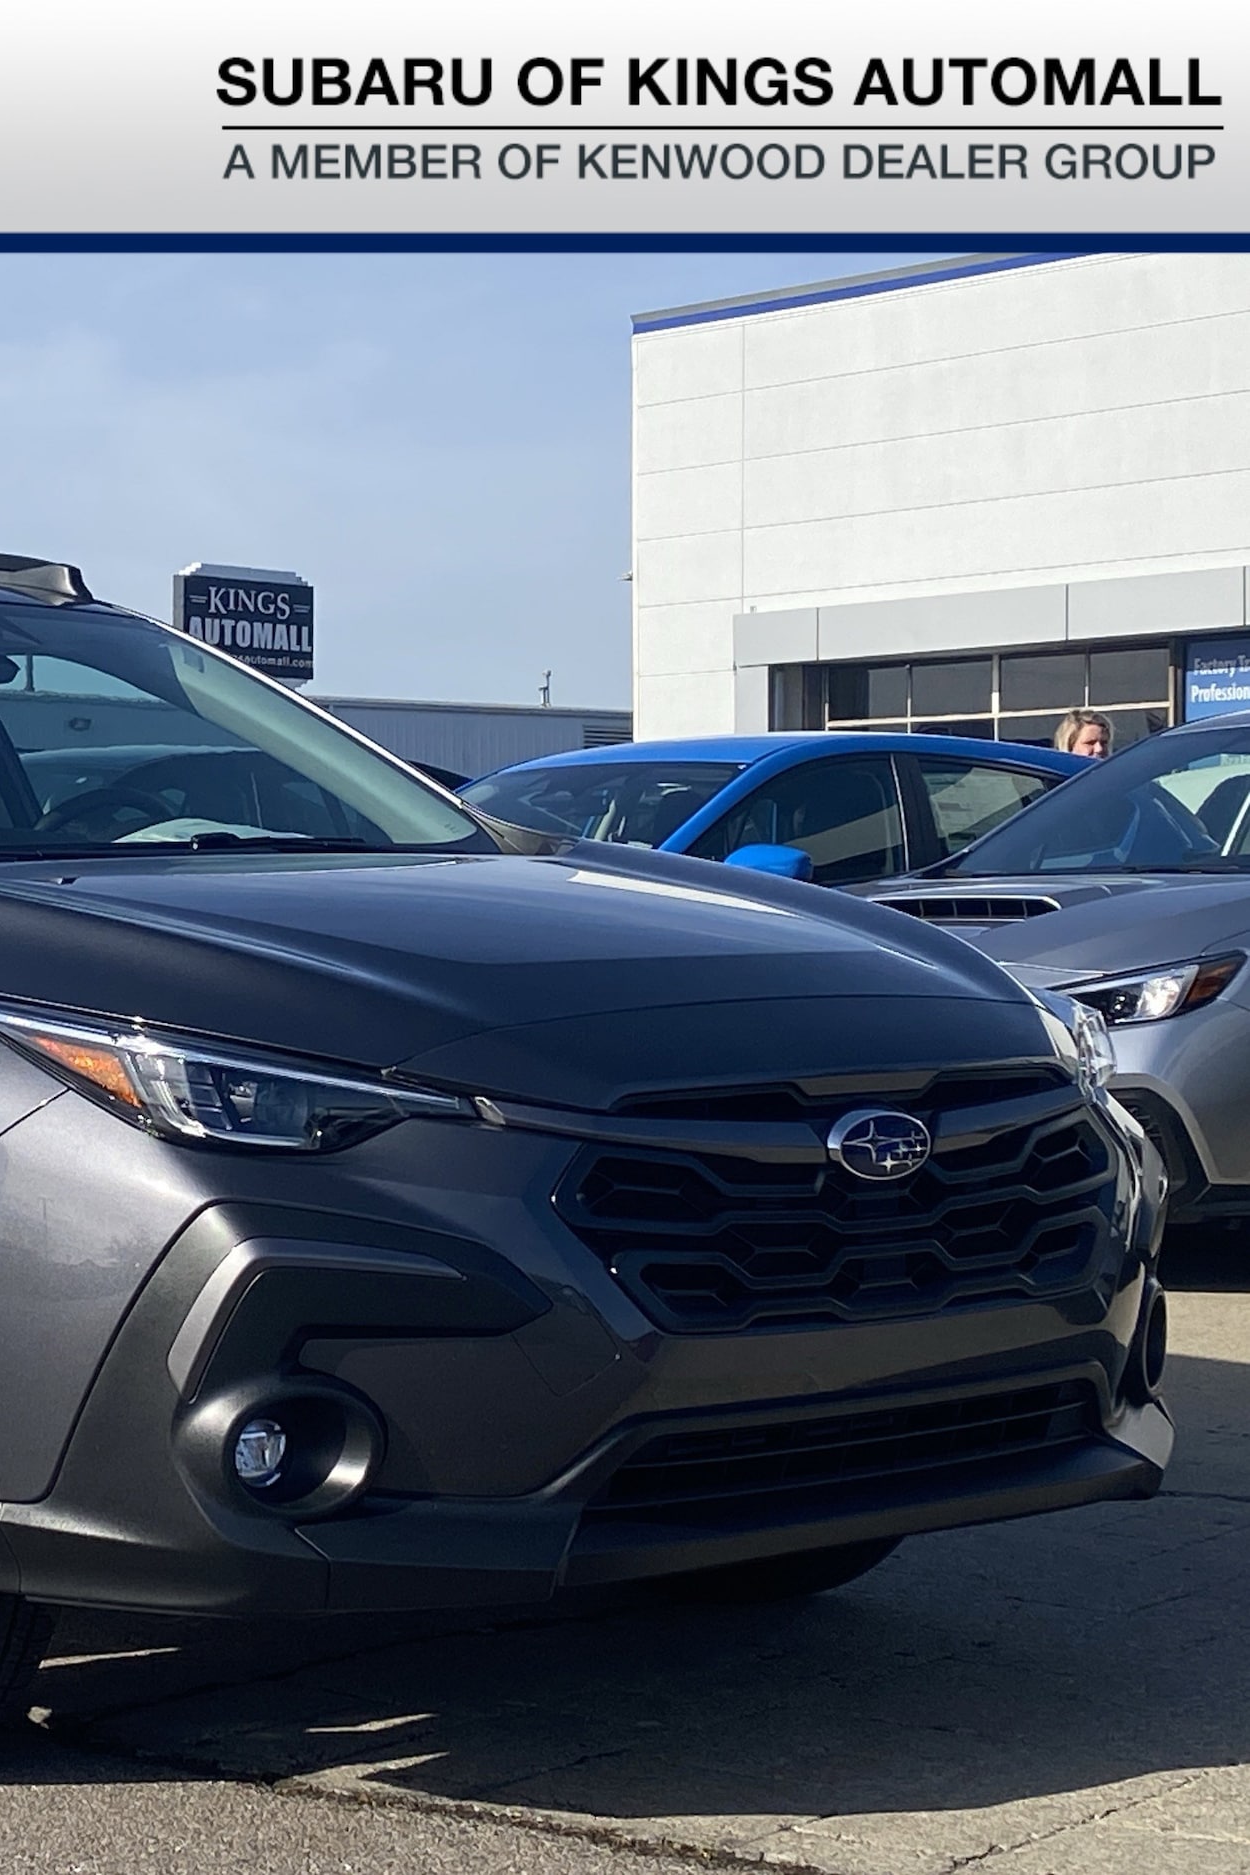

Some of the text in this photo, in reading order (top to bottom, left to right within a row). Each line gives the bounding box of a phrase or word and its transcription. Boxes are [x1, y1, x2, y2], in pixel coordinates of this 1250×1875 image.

[208, 586, 290, 620] KINGS
[189, 616, 312, 652] AUTOMALL
[1194, 657, 1237, 678] Factory
